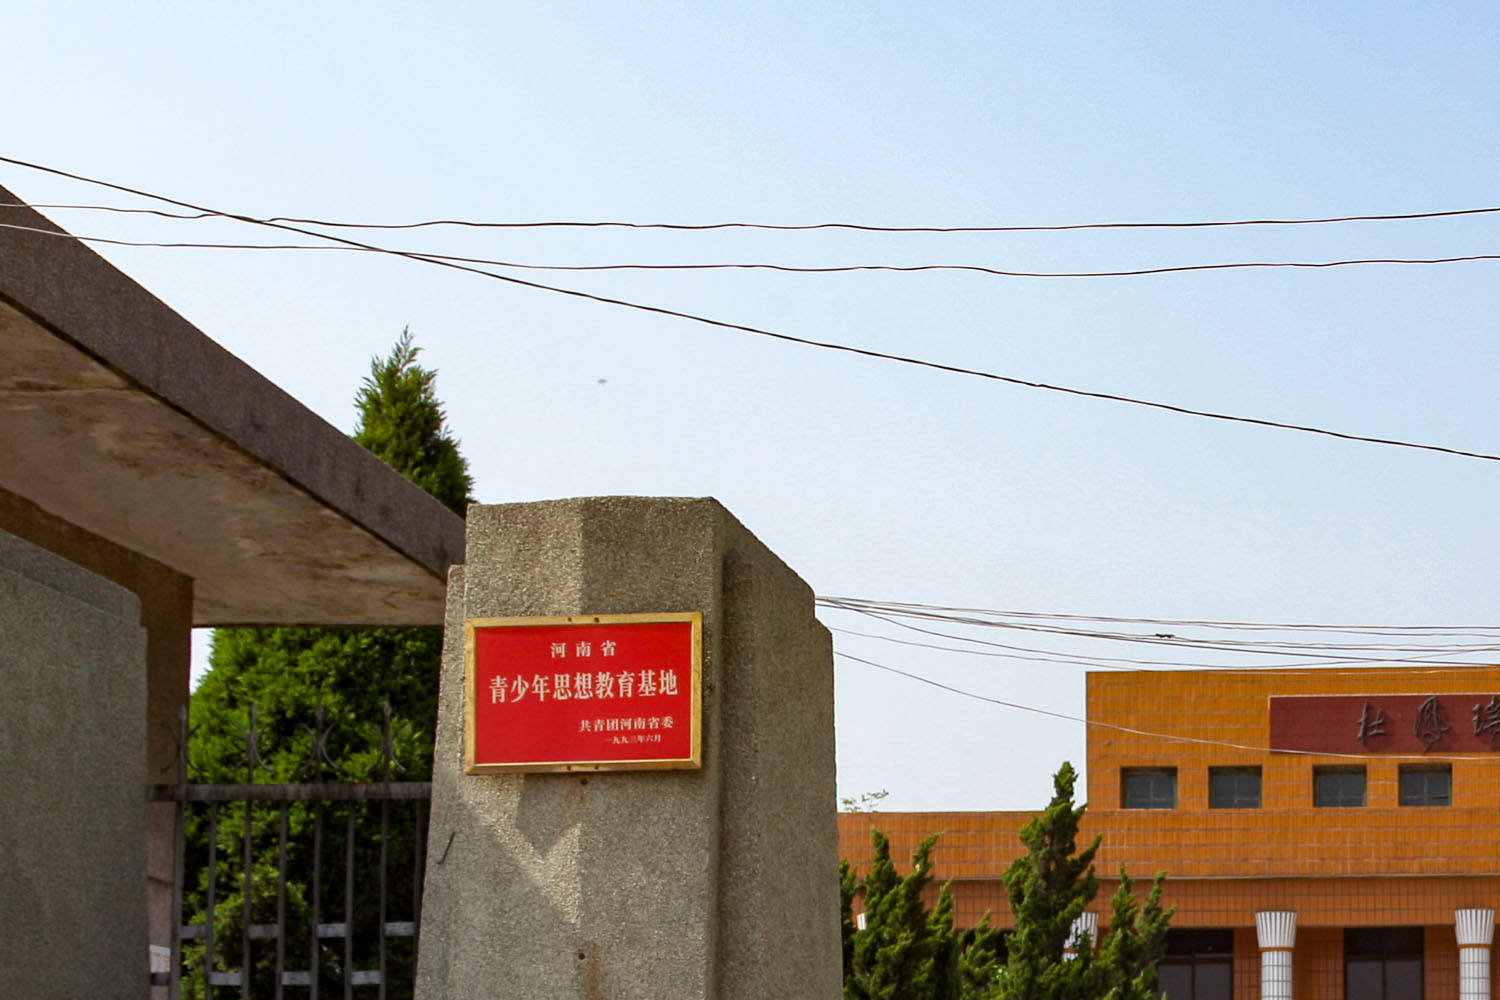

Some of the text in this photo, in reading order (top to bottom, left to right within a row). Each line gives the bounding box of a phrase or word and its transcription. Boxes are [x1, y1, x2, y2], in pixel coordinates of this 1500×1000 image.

[550, 640, 617, 659] 河南省
[489, 669, 679, 704] 青少年思想教育基地
[578, 715, 675, 733] 共青团河南省委
